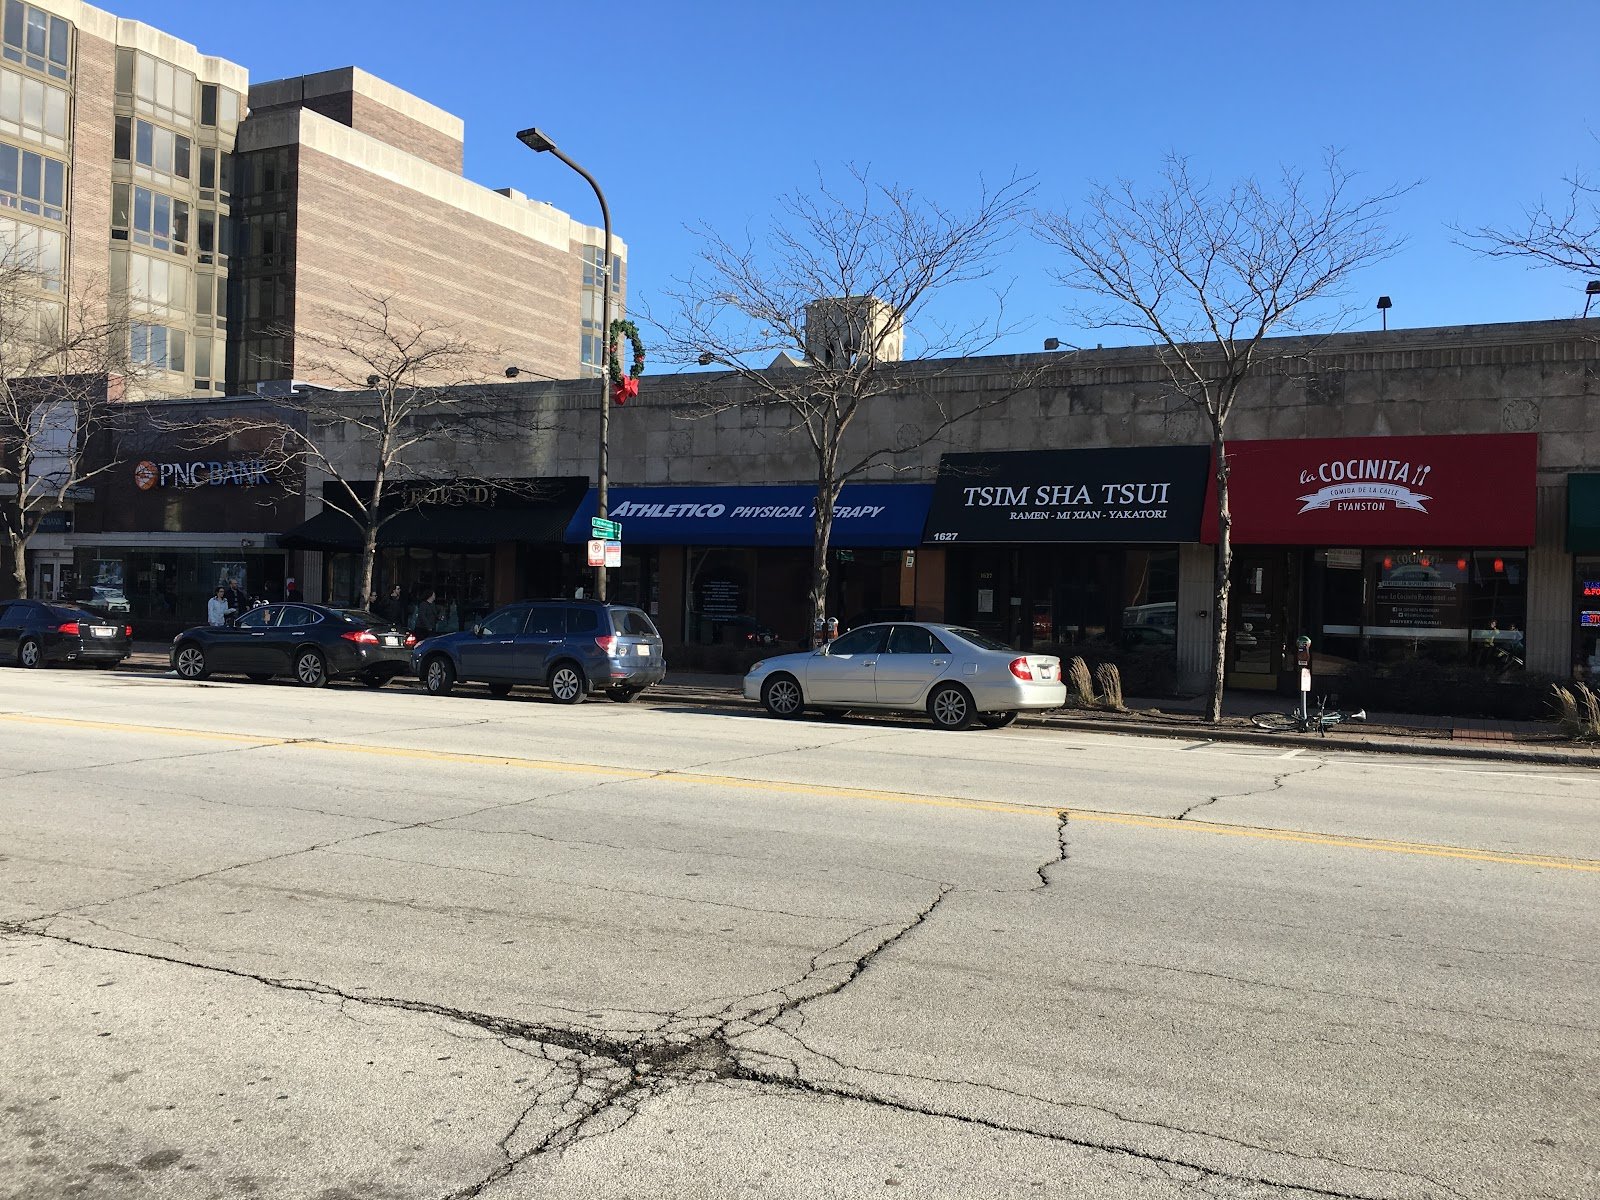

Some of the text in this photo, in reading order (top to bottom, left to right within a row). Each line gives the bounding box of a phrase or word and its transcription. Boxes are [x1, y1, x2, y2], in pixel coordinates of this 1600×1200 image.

[159, 461, 271, 487] PNC BANK
[1299, 459, 1411, 484] la COCINITA
[963, 483, 1171, 506] TSIM SHA TSUI
[1330, 487, 1356, 496] COMIDA
[1379, 487, 1399, 497] CALLE
[608, 500, 886, 519] ATHLETICO PHYSICAL TERAPY
[1337, 502, 1386, 512] EVANSTON
[1009, 511, 1049, 520] RAMEN
[1056, 511, 1070, 520] MI
[1073, 511, 1101, 520] XIAN
[1109, 510, 1168, 519] YAKATORI
[933, 532, 959, 541] 1627
